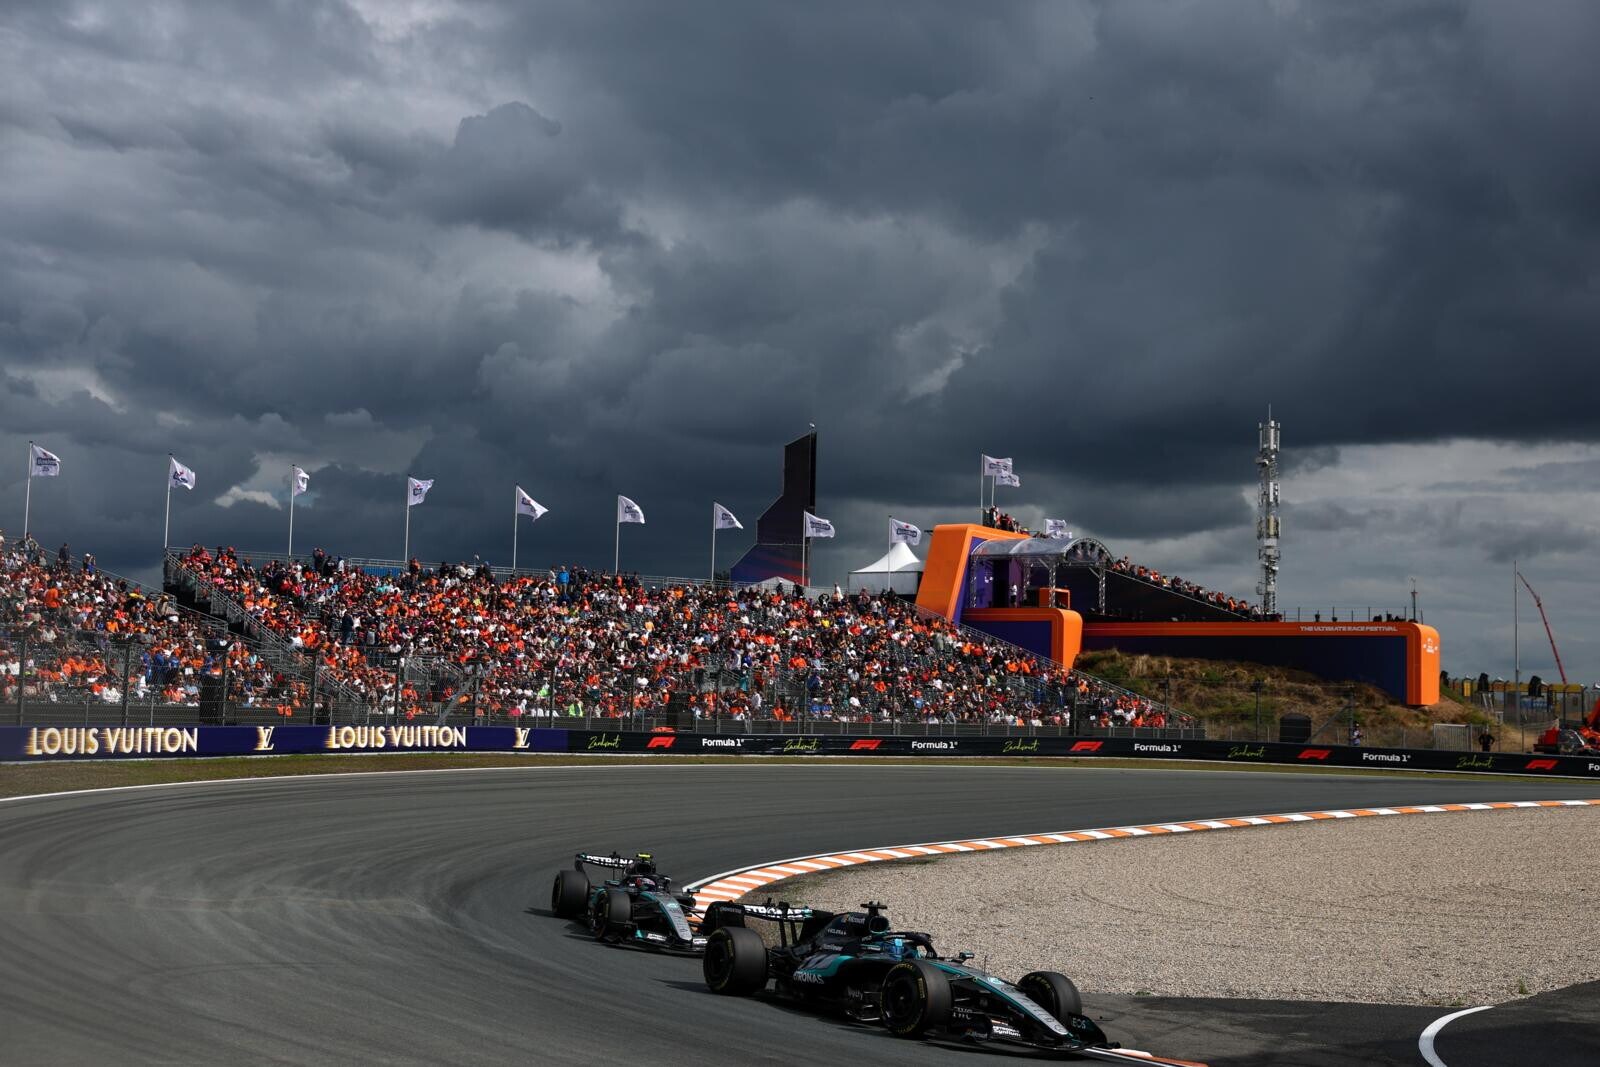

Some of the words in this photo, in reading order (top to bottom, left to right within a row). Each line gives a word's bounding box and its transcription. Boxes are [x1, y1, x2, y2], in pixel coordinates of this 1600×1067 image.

[26, 726, 100, 756] LOUIS
[104, 726, 198, 754] VUITTON
[325, 725, 387, 749] LOUIS
[389, 725, 467, 748] VUITTON
[702, 738, 735, 747] Formula
[911, 740, 948, 749] Formula
[1134, 743, 1171, 752] Formula
[1362, 752, 1401, 762] Formula
